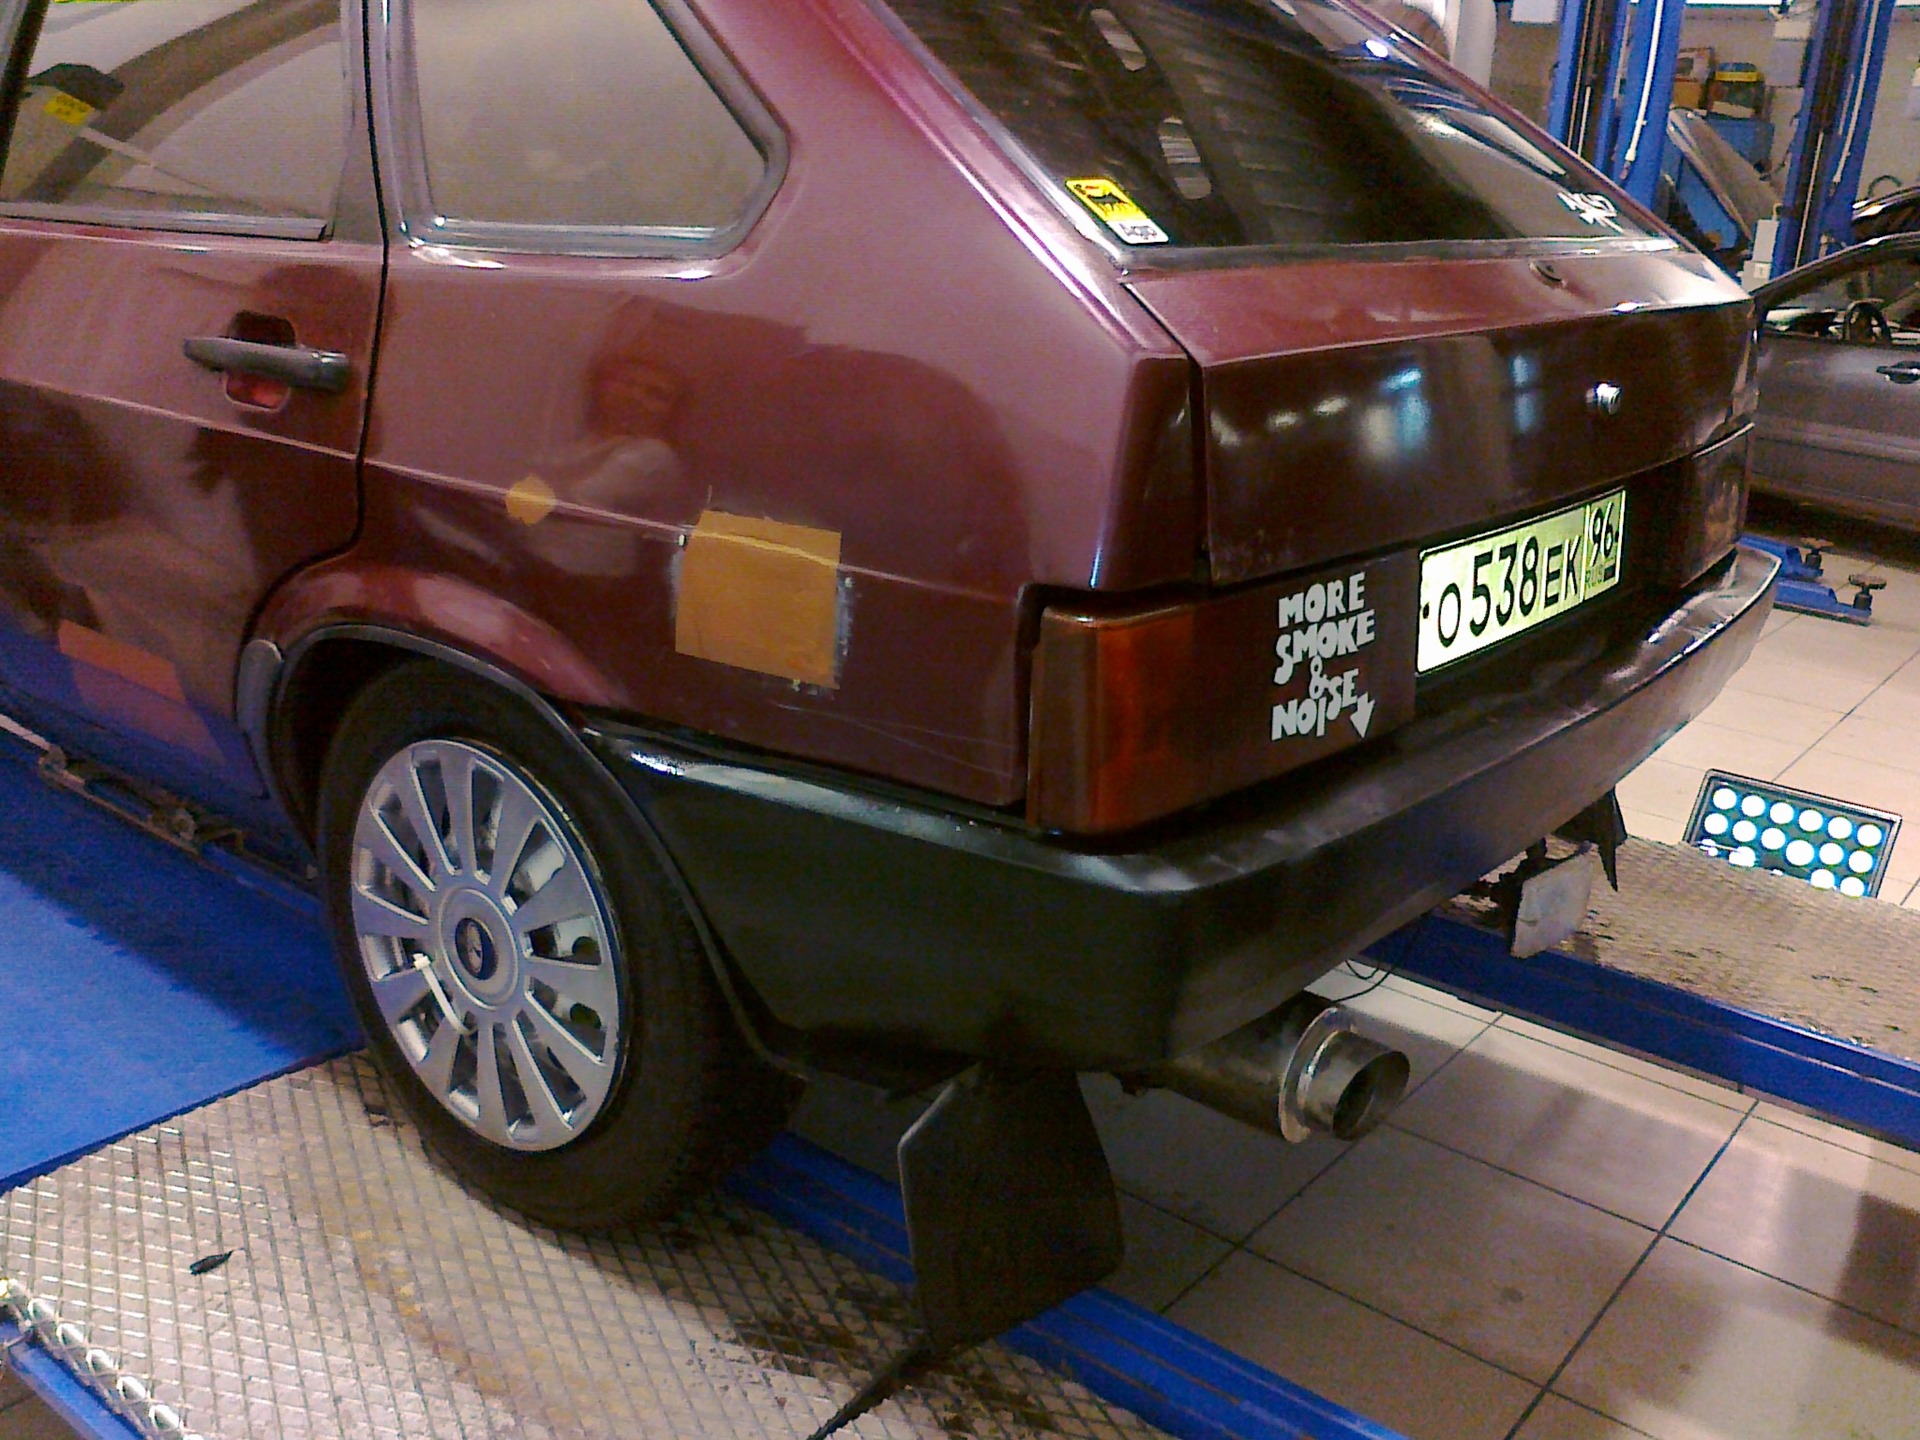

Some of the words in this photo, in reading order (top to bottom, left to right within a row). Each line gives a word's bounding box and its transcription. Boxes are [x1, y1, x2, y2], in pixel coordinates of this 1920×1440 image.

[1590, 502, 1614, 567] 96
[1278, 571, 1366, 629] MORE
[1273, 609, 1376, 685] SMOKE
[1308, 655, 1330, 700] &
[1271, 668, 1360, 742] NOISE
